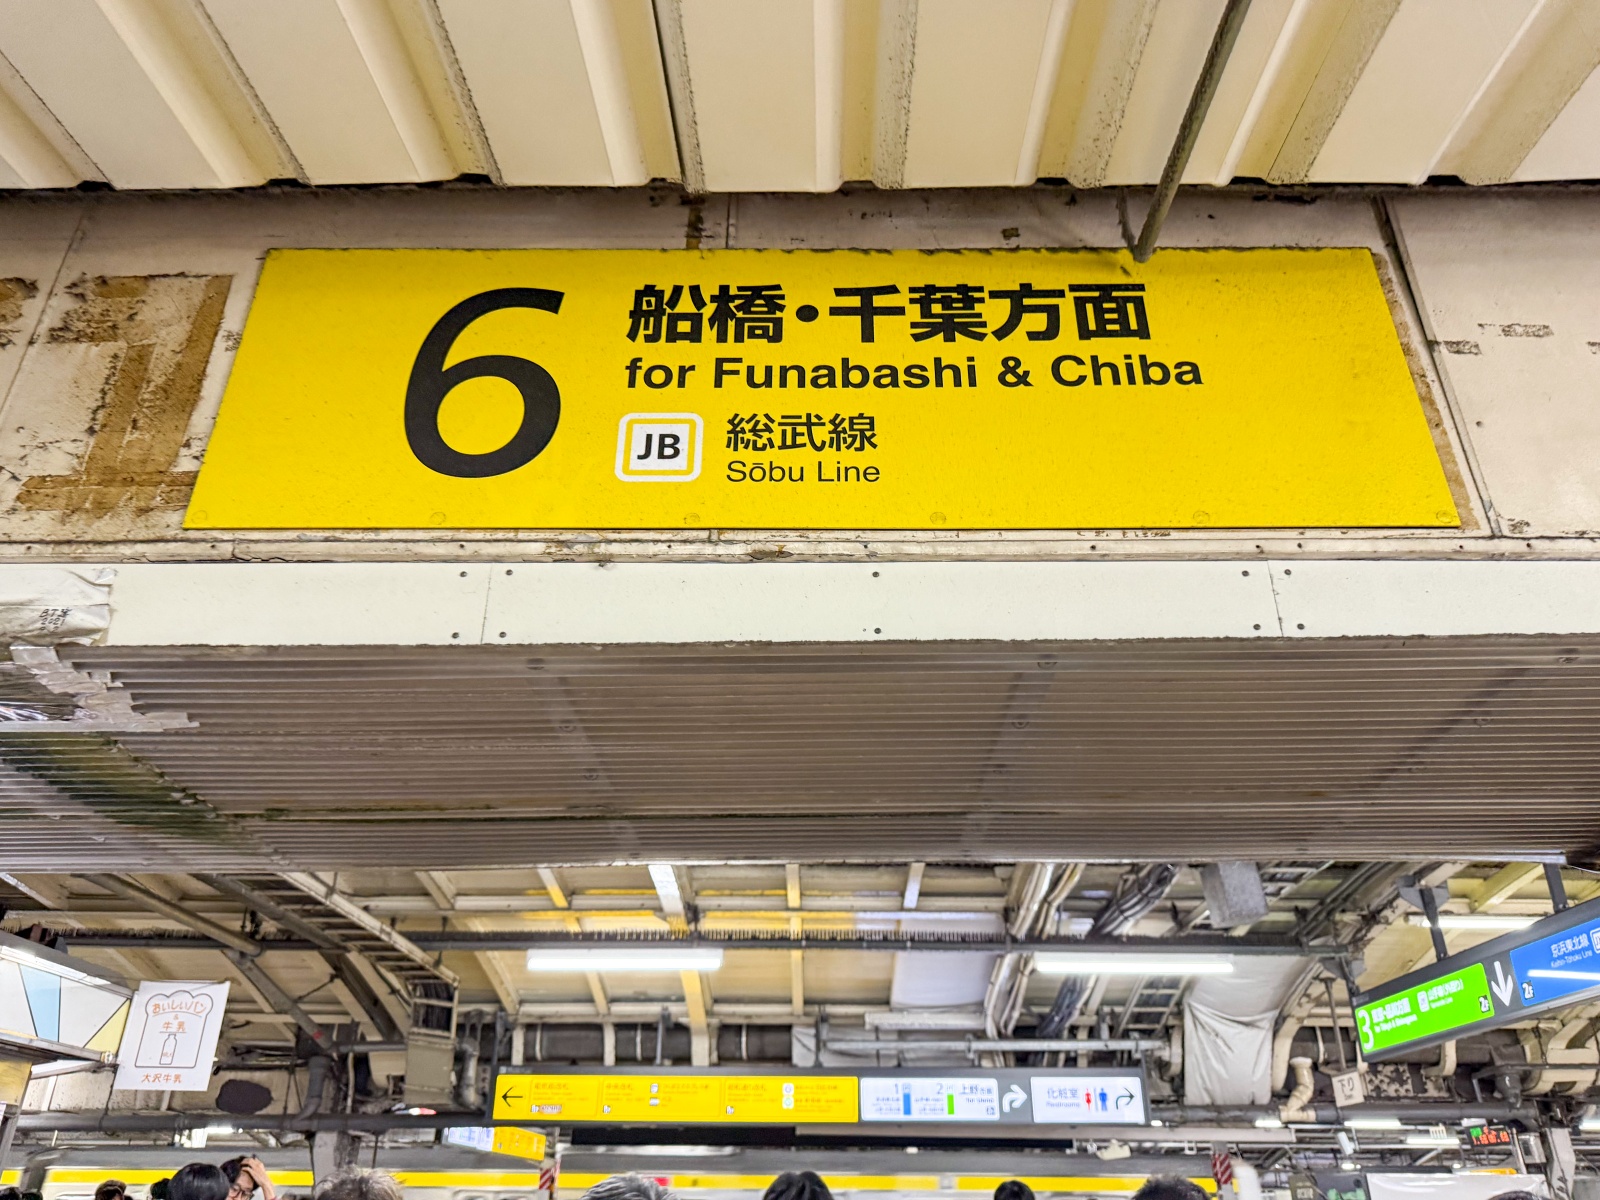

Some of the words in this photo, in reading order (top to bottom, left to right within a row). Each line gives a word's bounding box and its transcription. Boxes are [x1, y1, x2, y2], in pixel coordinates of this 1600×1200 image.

[626, 283, 1150, 345] 船橋・千葉方面
[405, 288, 564, 478] 6
[626, 358, 696, 389] for
[714, 357, 976, 389] Funabashi
[998, 357, 1034, 388] &
[1052, 355, 1203, 387] Chiba
[637, 433, 681, 460] JB
[726, 412, 878, 453] 総武線
[726, 460, 804, 483] Sōbu
[817, 460, 880, 483] Line
[152, 999, 207, 1014] おいしいパン
[1358, 1009, 1375, 1050] 3
[936, 1083, 944, 1095] 2
